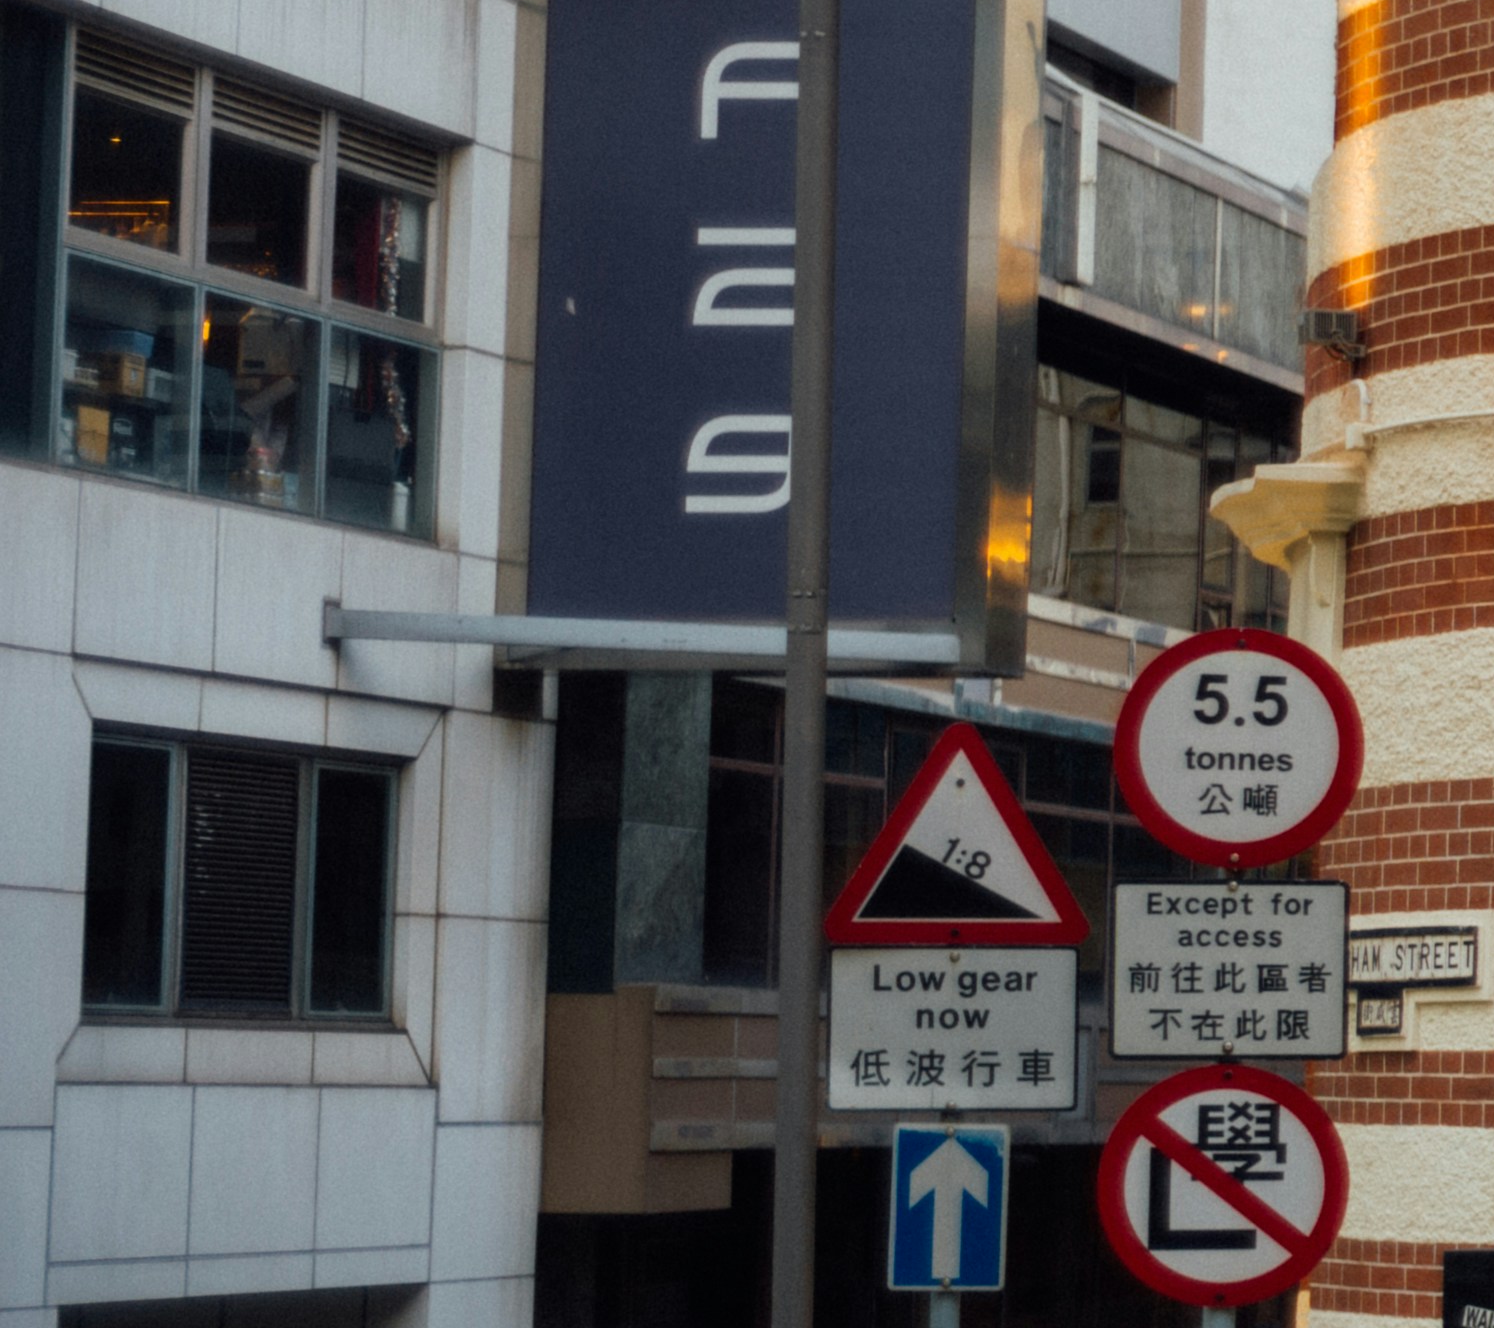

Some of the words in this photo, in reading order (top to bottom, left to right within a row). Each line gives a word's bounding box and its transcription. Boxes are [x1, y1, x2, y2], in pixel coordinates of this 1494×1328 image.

[1193, 675, 1290, 727] 5.5
[1184, 746, 1293, 773] tonnes
[1198, 783, 1278, 817] 公噸
[940, 837, 992, 880] 1:8
[1146, 892, 1254, 920] Except
[1270, 892, 1315, 916] for
[1177, 929, 1283, 948] access
[1395, 940, 1476, 971] STREET
[873, 964, 953, 993] Low
[958, 969, 1038, 999] gear
[1128, 961, 1332, 994] 前往此區者
[914, 1008, 990, 1030] now
[1148, 1008, 1310, 1042] 不在此限
[849, 1048, 1056, 1088] 低波行車
